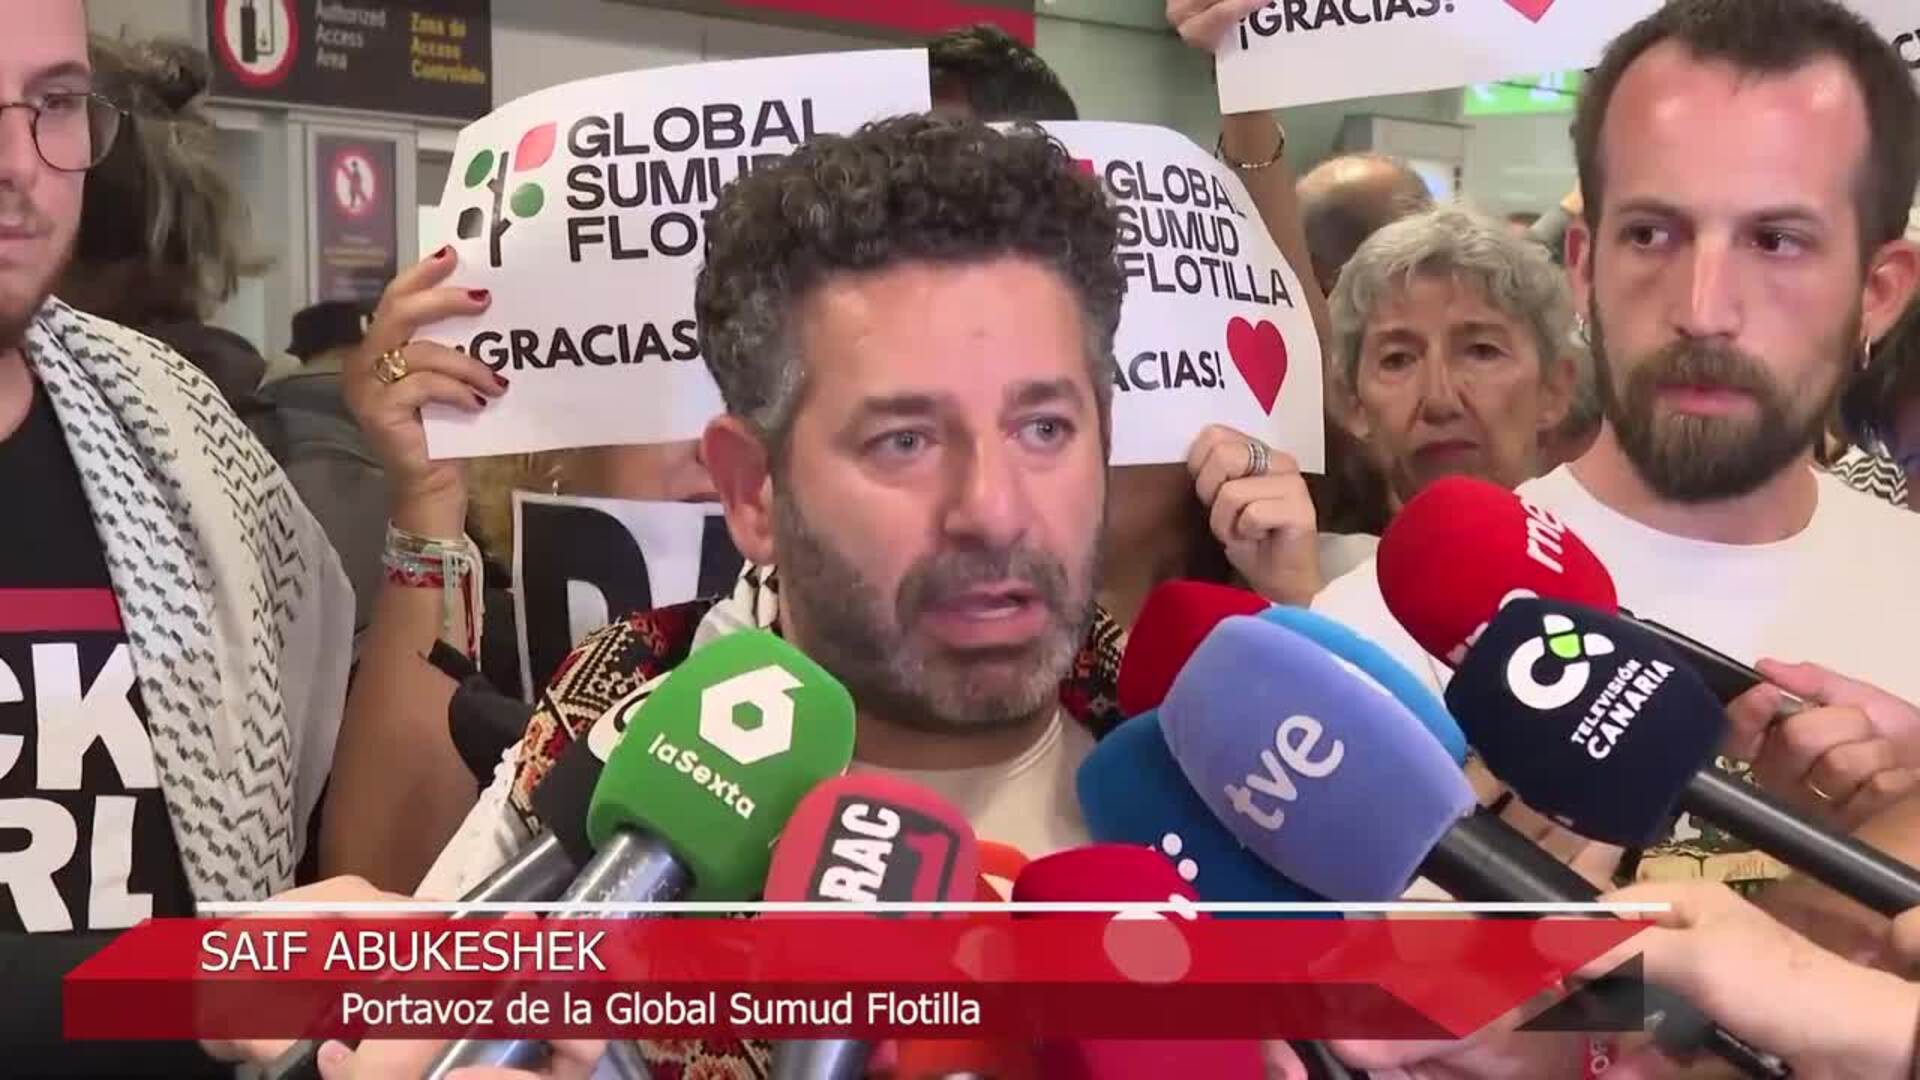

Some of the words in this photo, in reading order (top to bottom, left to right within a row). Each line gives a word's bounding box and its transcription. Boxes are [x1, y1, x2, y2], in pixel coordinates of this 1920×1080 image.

[315, 24, 364, 48] Access
[1117, 251, 1294, 308] FLOTILLA
[1571, 659, 1642, 745] TELEVISIÓN
[1586, 659, 1675, 760] CANARIA
[648, 731, 756, 820] laSexta
[1223, 715, 1345, 830] tve
